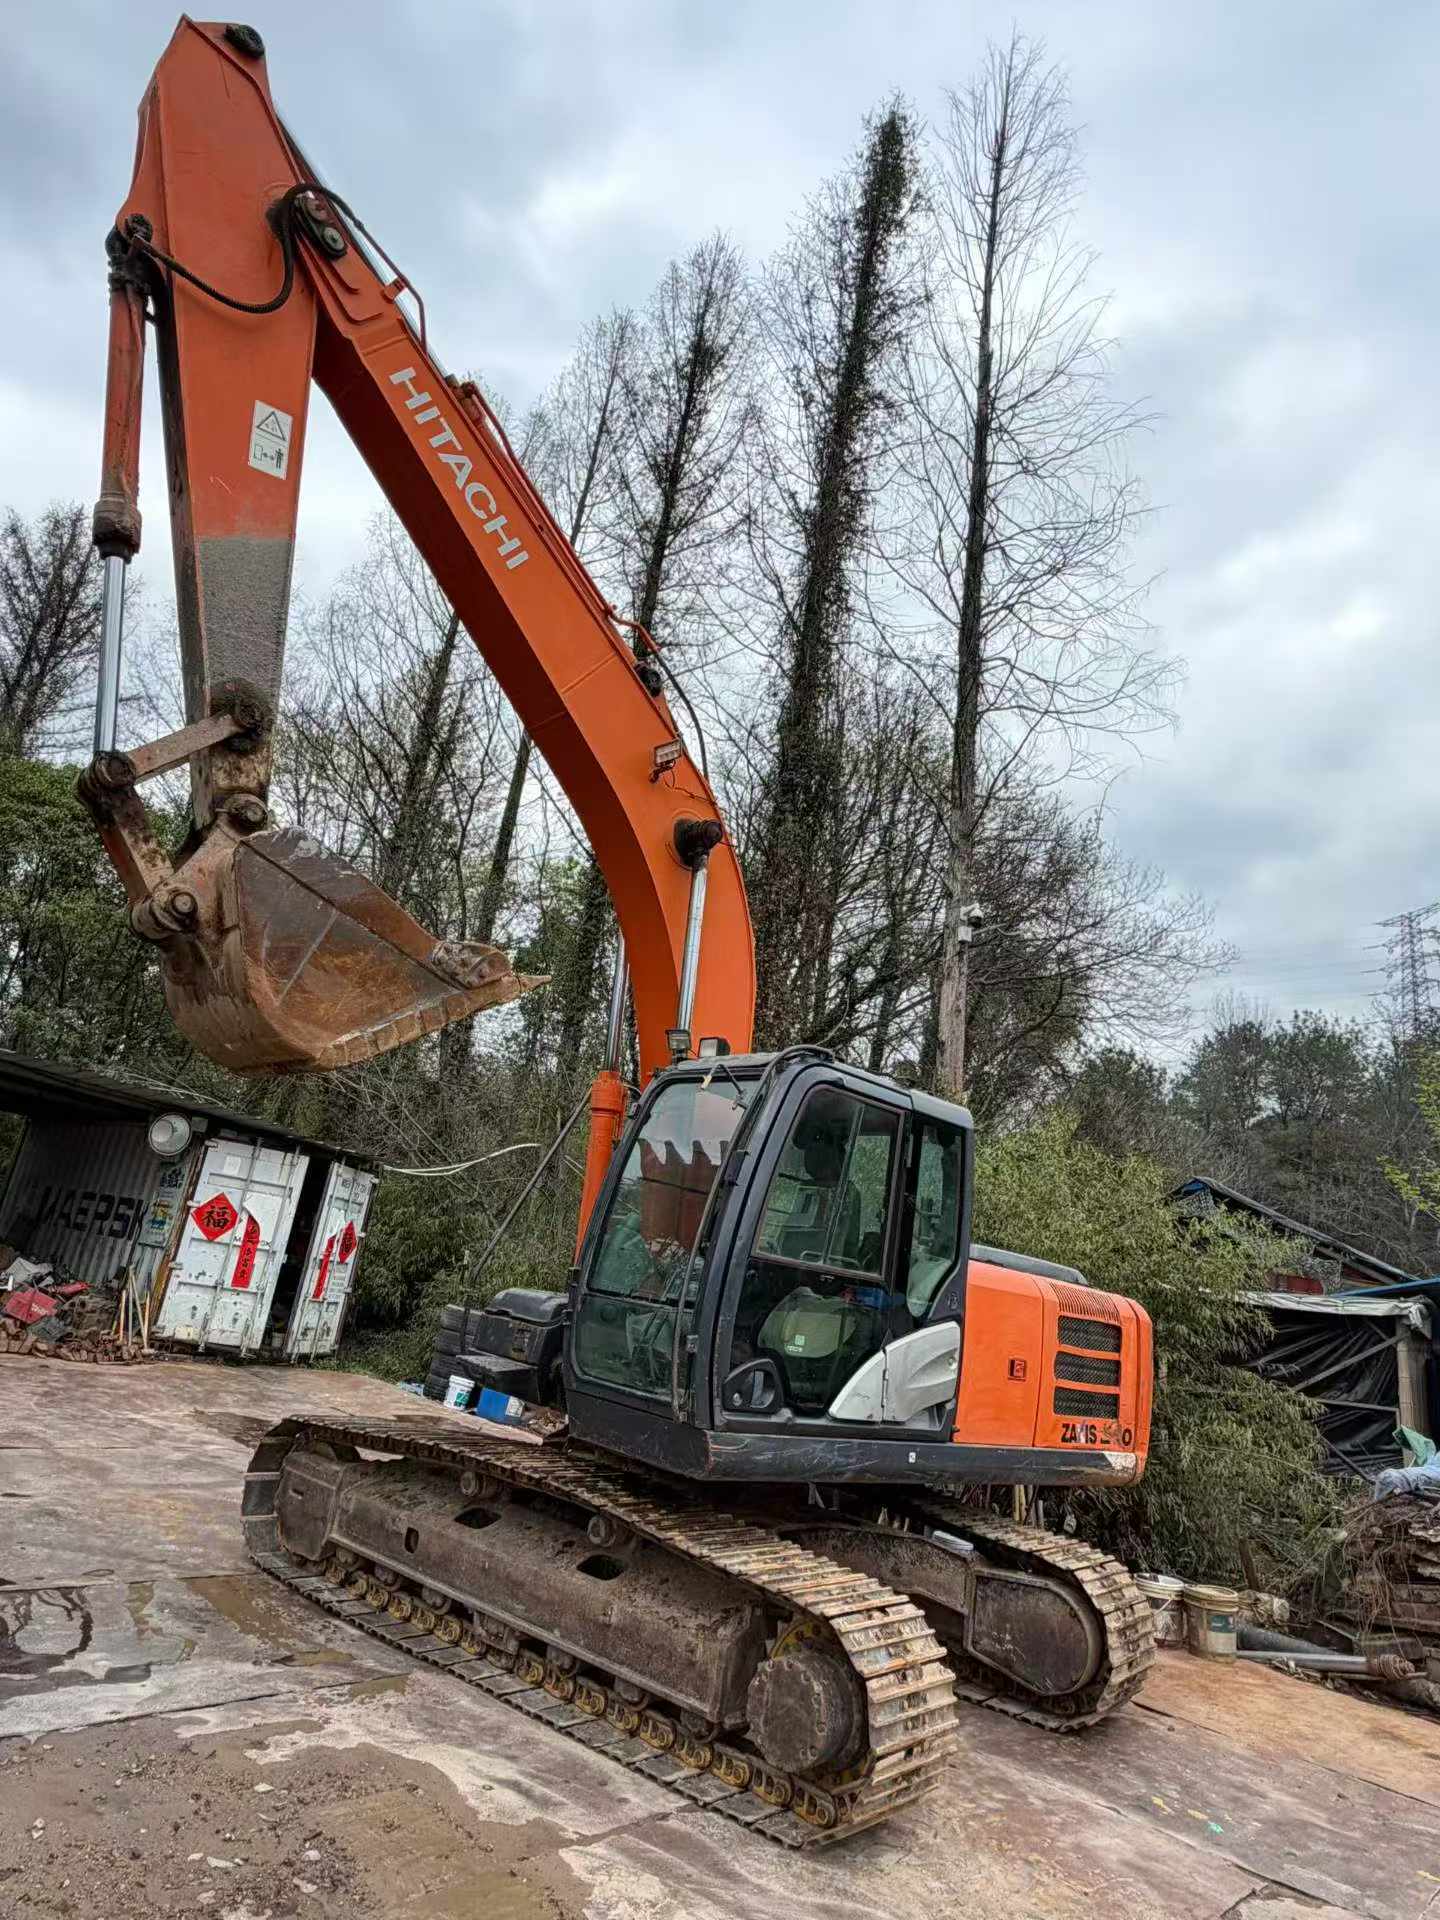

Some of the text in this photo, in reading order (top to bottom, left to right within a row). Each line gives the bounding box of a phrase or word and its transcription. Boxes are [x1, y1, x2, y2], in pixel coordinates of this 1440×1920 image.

[389, 367, 529, 570] HITACHI
[36, 1186, 143, 1240] AERS
[202, 1205, 230, 1229] 福
